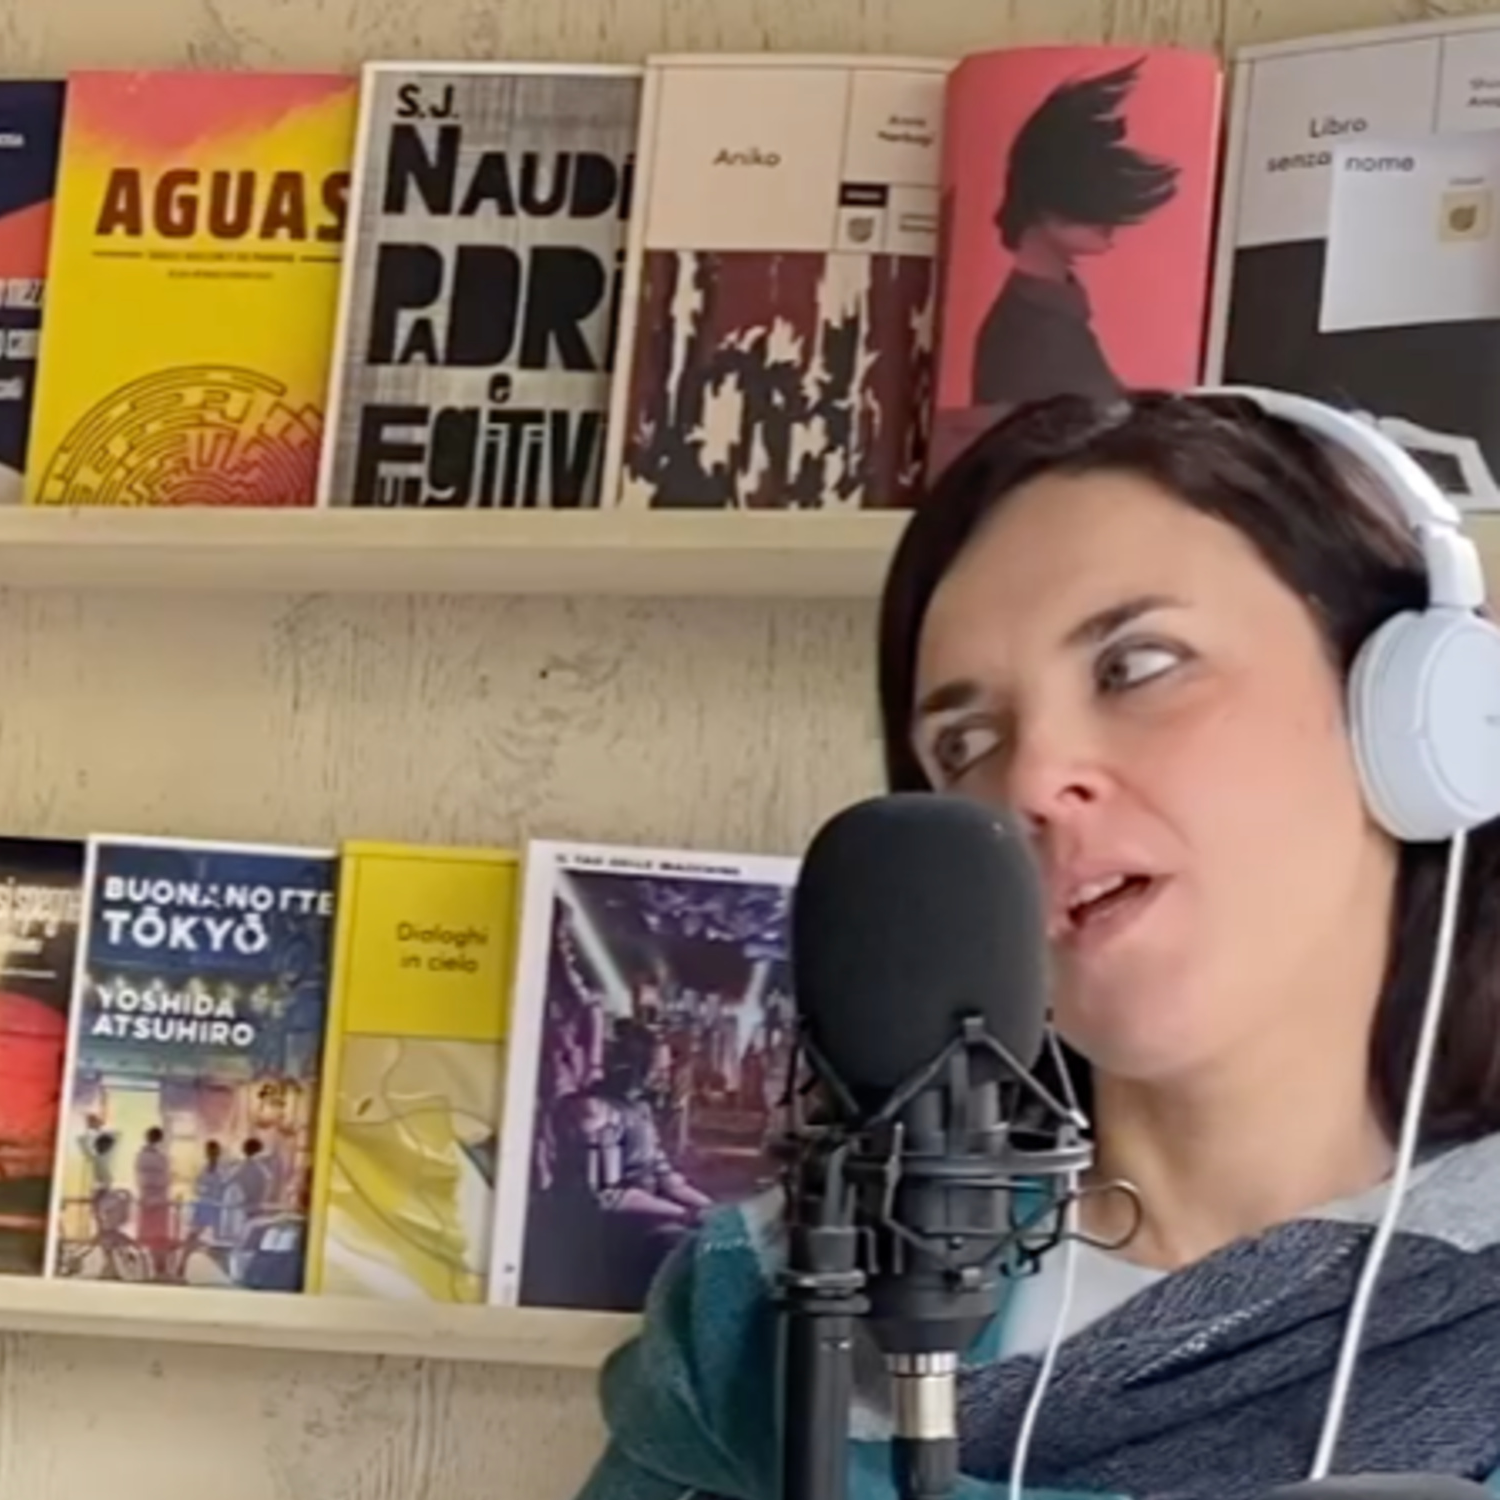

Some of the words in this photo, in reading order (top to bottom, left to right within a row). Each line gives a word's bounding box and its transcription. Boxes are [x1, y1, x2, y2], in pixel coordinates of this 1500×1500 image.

[395, 84, 459, 118] S.J.
[1309, 117, 1367, 138] Libro
[713, 148, 781, 166] Aniko
[1267, 151, 1332, 172] senza
[1344, 156, 1415, 172] nome
[95, 167, 351, 242] AGUAS
[487, 372, 512, 403] e
[103, 876, 335, 916] BUONANOTTE
[397, 921, 489, 949] Dialoghi
[400, 951, 422, 969] in
[428, 952, 479, 974] cielo
[96, 981, 236, 1019] YOSHIDA
[92, 1013, 255, 1046] ATSUHIRO
